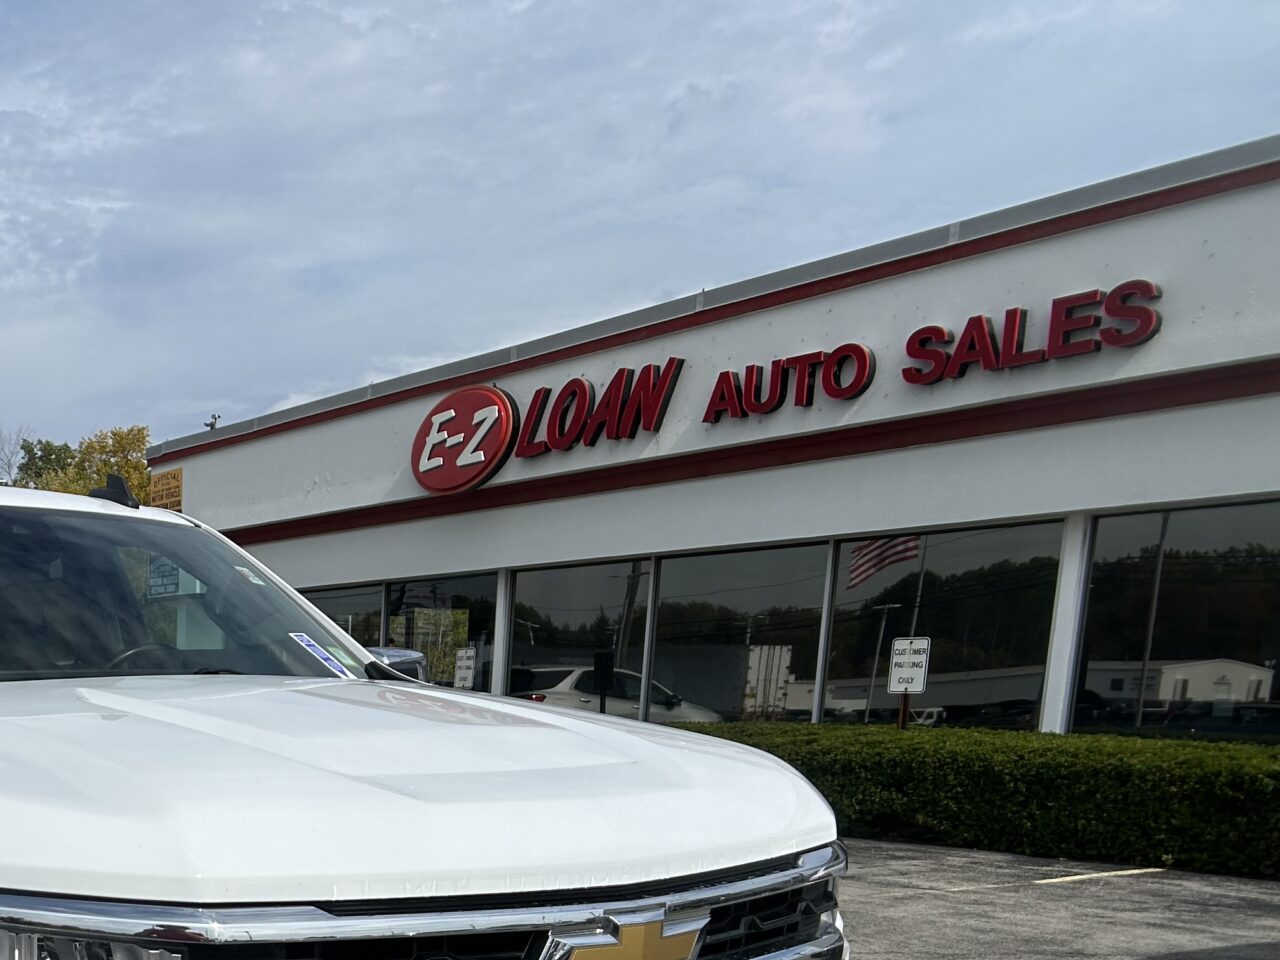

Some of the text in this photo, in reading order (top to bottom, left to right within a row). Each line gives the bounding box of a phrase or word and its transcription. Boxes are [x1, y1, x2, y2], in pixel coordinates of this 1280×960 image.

[417, 278, 1163, 473] E-Z LOAN AUTO SALES
[894, 648, 927, 656] CUSOMER
[898, 676, 915, 684] ONLY
